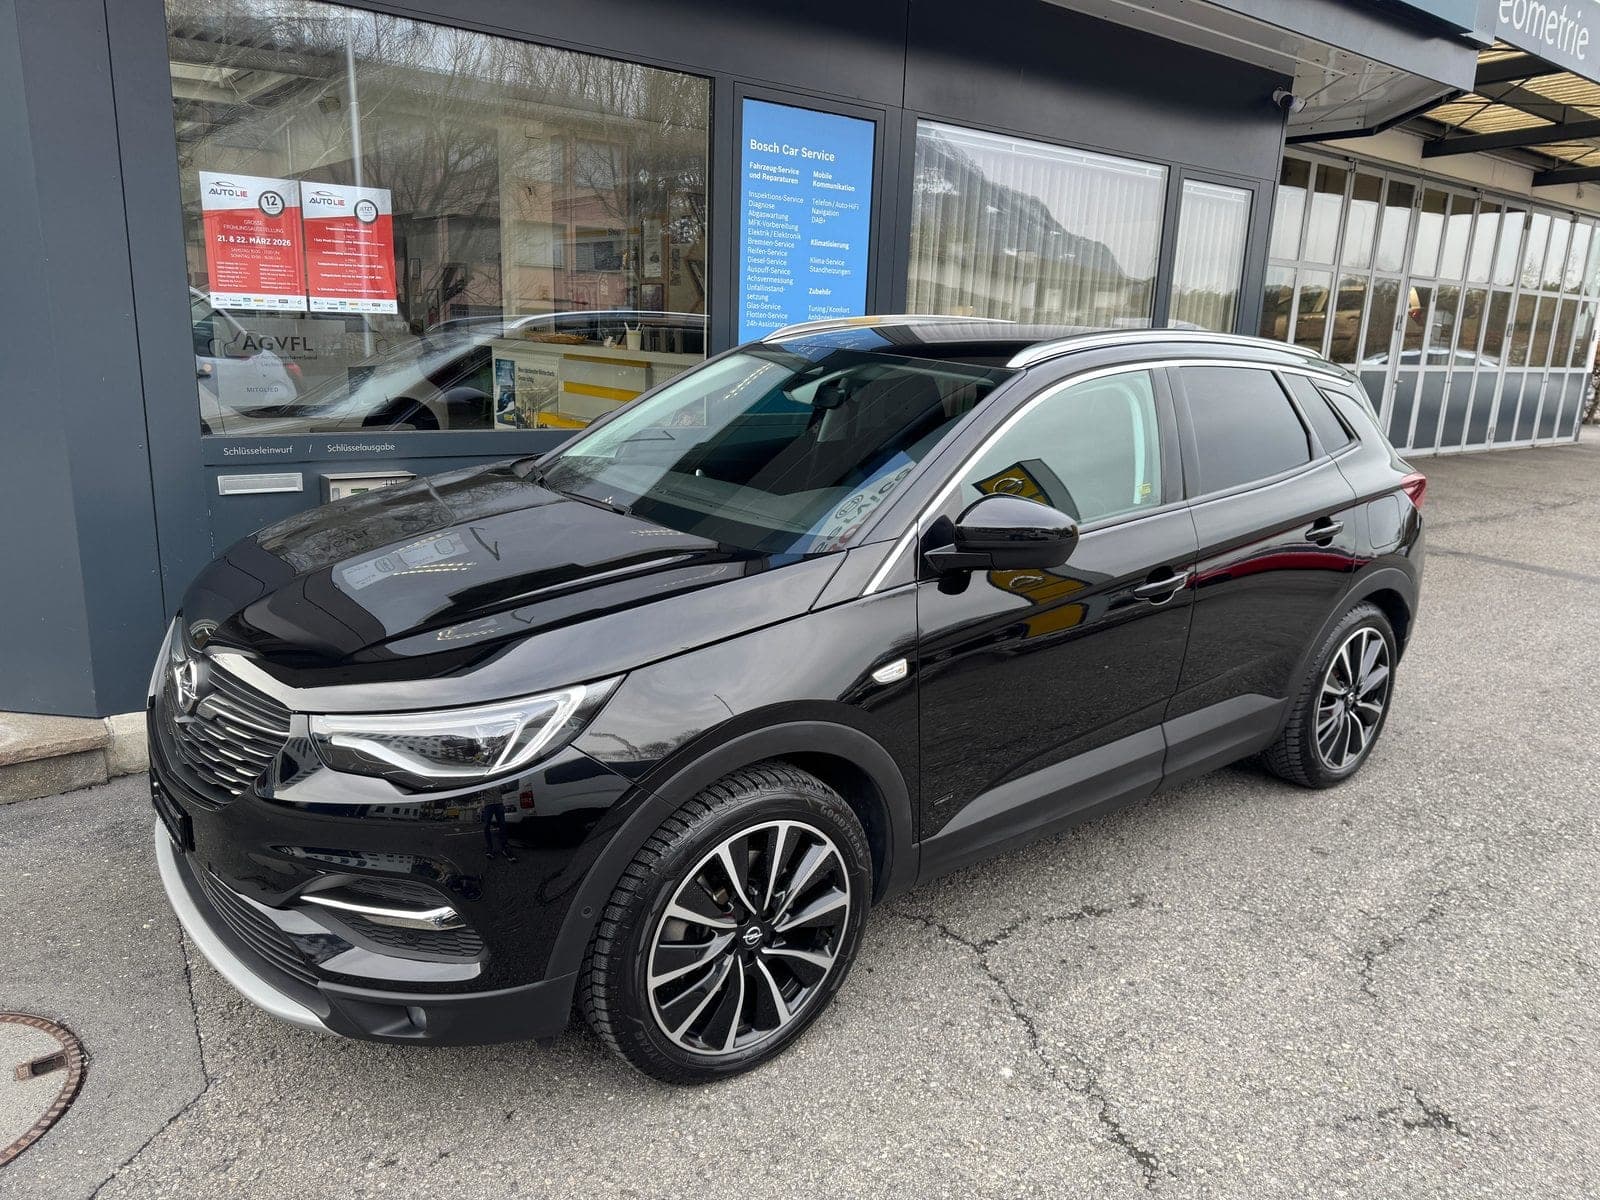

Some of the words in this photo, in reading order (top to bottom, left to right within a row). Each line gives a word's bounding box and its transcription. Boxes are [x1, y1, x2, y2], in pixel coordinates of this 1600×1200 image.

[750, 139, 780, 154] Bosch
[782, 144, 799, 156] Car
[801, 147, 835, 162] Service
[749, 161, 800, 176] Fahrzeug-Service
[749, 172, 761, 180] und
[761, 173, 799, 185] Reparaturen
[812, 170, 833, 180] Mobile
[812, 180, 856, 192] Kommunikation
[264, 195, 278, 207] 12
[748, 191, 804, 204] Inspektions-Service
[748, 200, 775, 210] Diagnose
[748, 209, 790, 221] Abgaswartung
[811, 207, 840, 217] Navigation
[748, 219, 799, 232] MFK-Vorbereitung
[217, 234, 228, 243] 21.
[229, 235, 235, 243] &
[236, 236, 248, 244] 22.
[249, 235, 271, 245] MÄRZ
[272, 238, 292, 247] 2026
[748, 238, 795, 249] Bremsen-Service
[810, 239, 850, 250] Klimatisierung
[747, 247, 788, 257] Reifen-Service
[747, 256, 787, 266] Diesel-Service
[810, 257, 845, 266] Klima-Service
[747, 265, 792, 276] Auspuff-Service
[809, 265, 852, 277] Standheizungen
[747, 275, 794, 286] Achsvermessung
[808, 287, 832, 296] Zubehör
[746, 294, 769, 302] setzung
[746, 302, 781, 311] Glas-Service
[746, 310, 788, 320] Flotten-Service
[242, 335, 314, 352] AGVFL
[223, 445, 293, 456] Schlüsseleinwurf
[308, 444, 313, 454] /
[327, 442, 396, 453] Schlüsselausgabe
